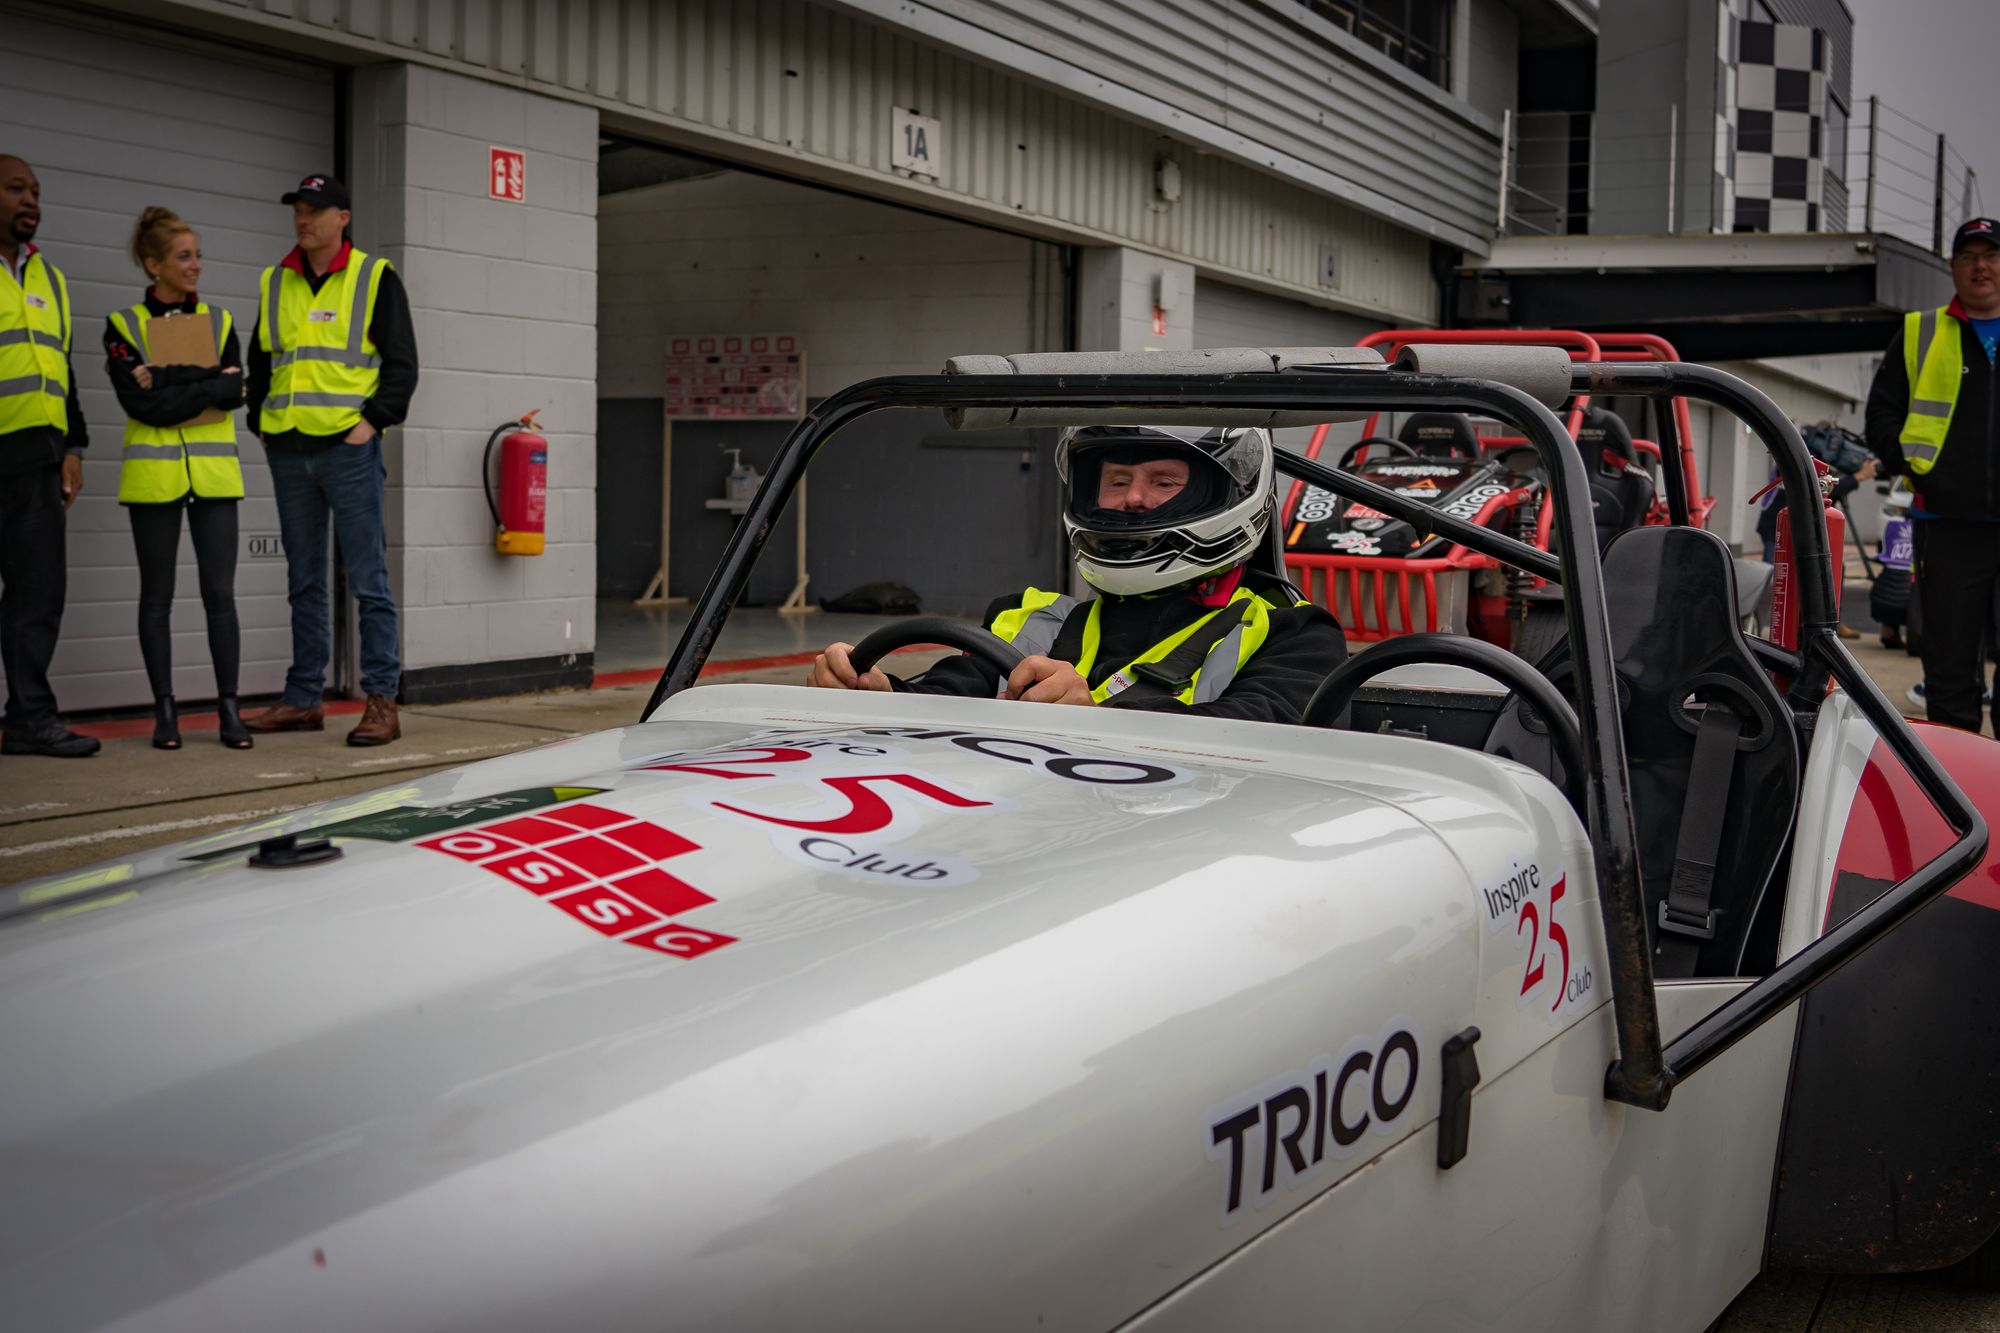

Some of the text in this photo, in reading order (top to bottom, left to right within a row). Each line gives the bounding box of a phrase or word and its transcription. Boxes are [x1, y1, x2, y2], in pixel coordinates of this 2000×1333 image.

[904, 124, 929, 161] 1A
[625, 747, 995, 835] 25
[799, 837, 950, 881] Club
[1484, 862, 1541, 920] Inspire
[1517, 871, 1570, 1013] 25
[1567, 965, 1593, 1003] Club
[1211, 1029, 1419, 1214] TRICO
